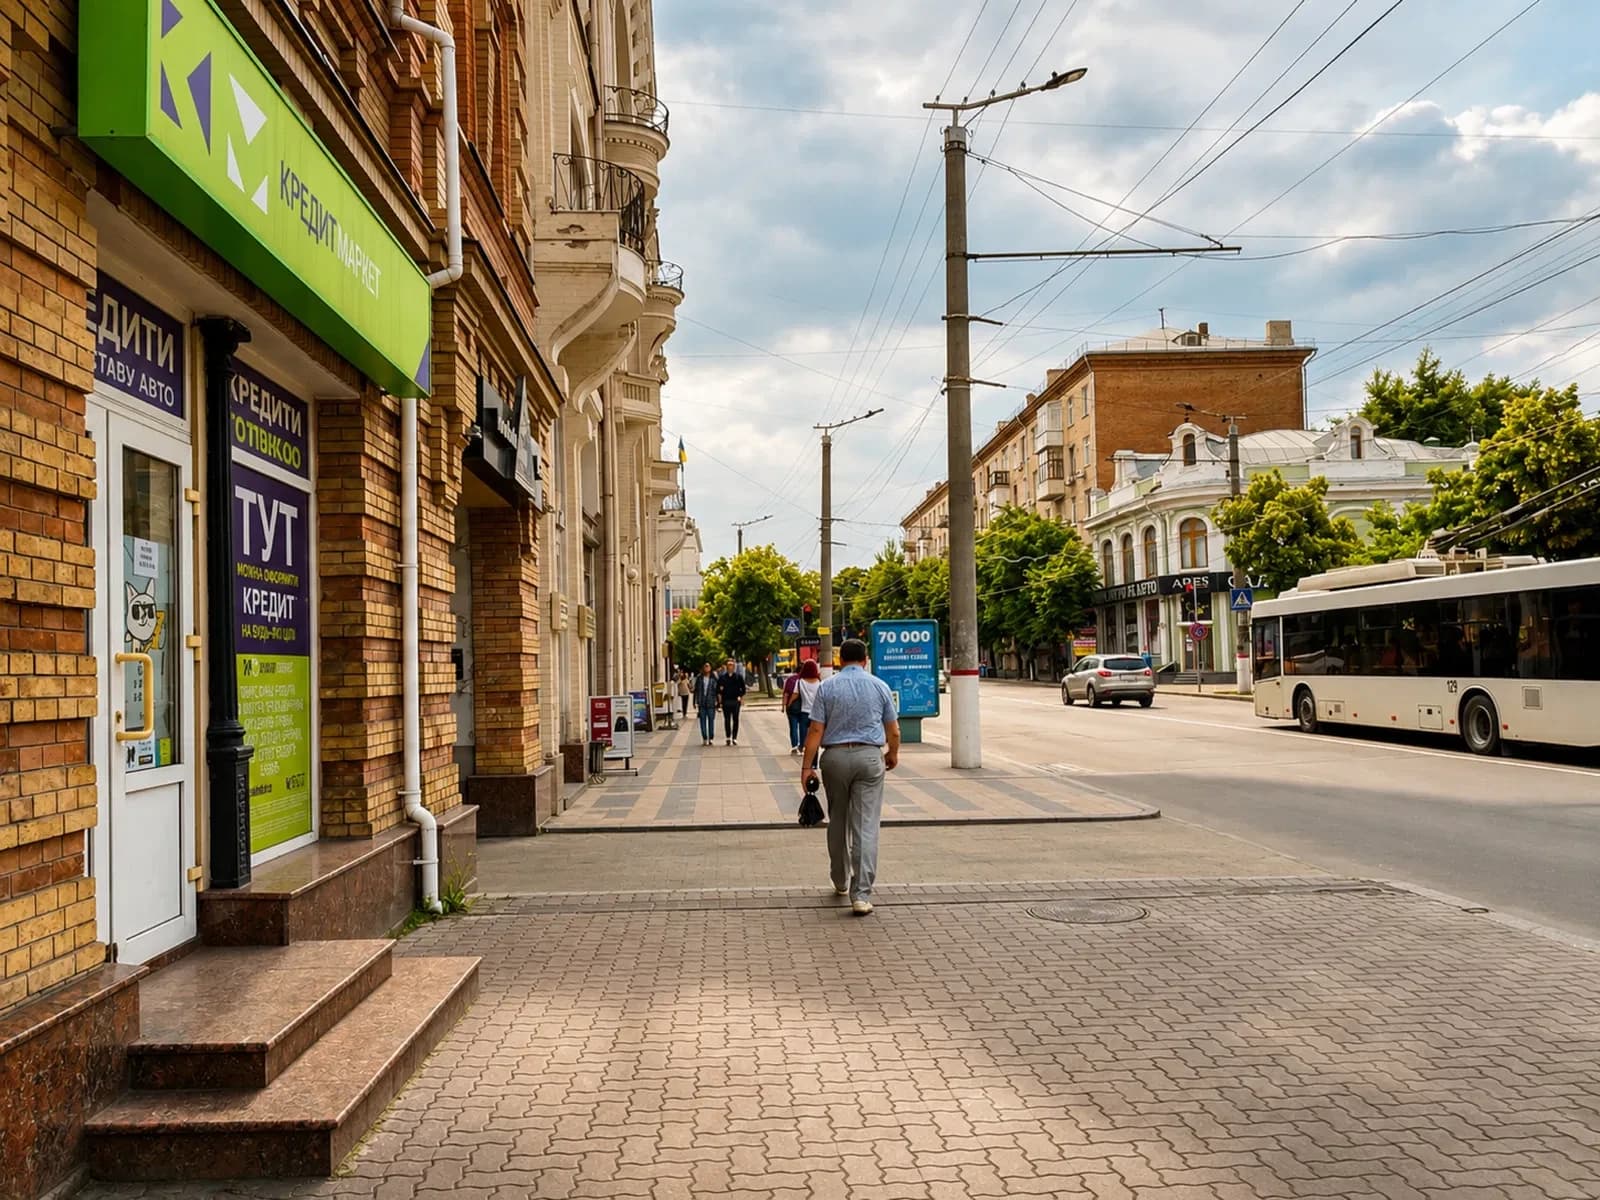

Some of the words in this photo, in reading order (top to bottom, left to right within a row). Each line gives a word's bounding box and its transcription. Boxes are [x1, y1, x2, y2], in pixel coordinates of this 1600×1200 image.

[138, 372, 175, 408] АВТО
[234, 485, 298, 566] ТУТ
[878, 631, 897, 643] 70
[900, 630, 931, 643] 000
[1446, 680, 1458, 693] 129
